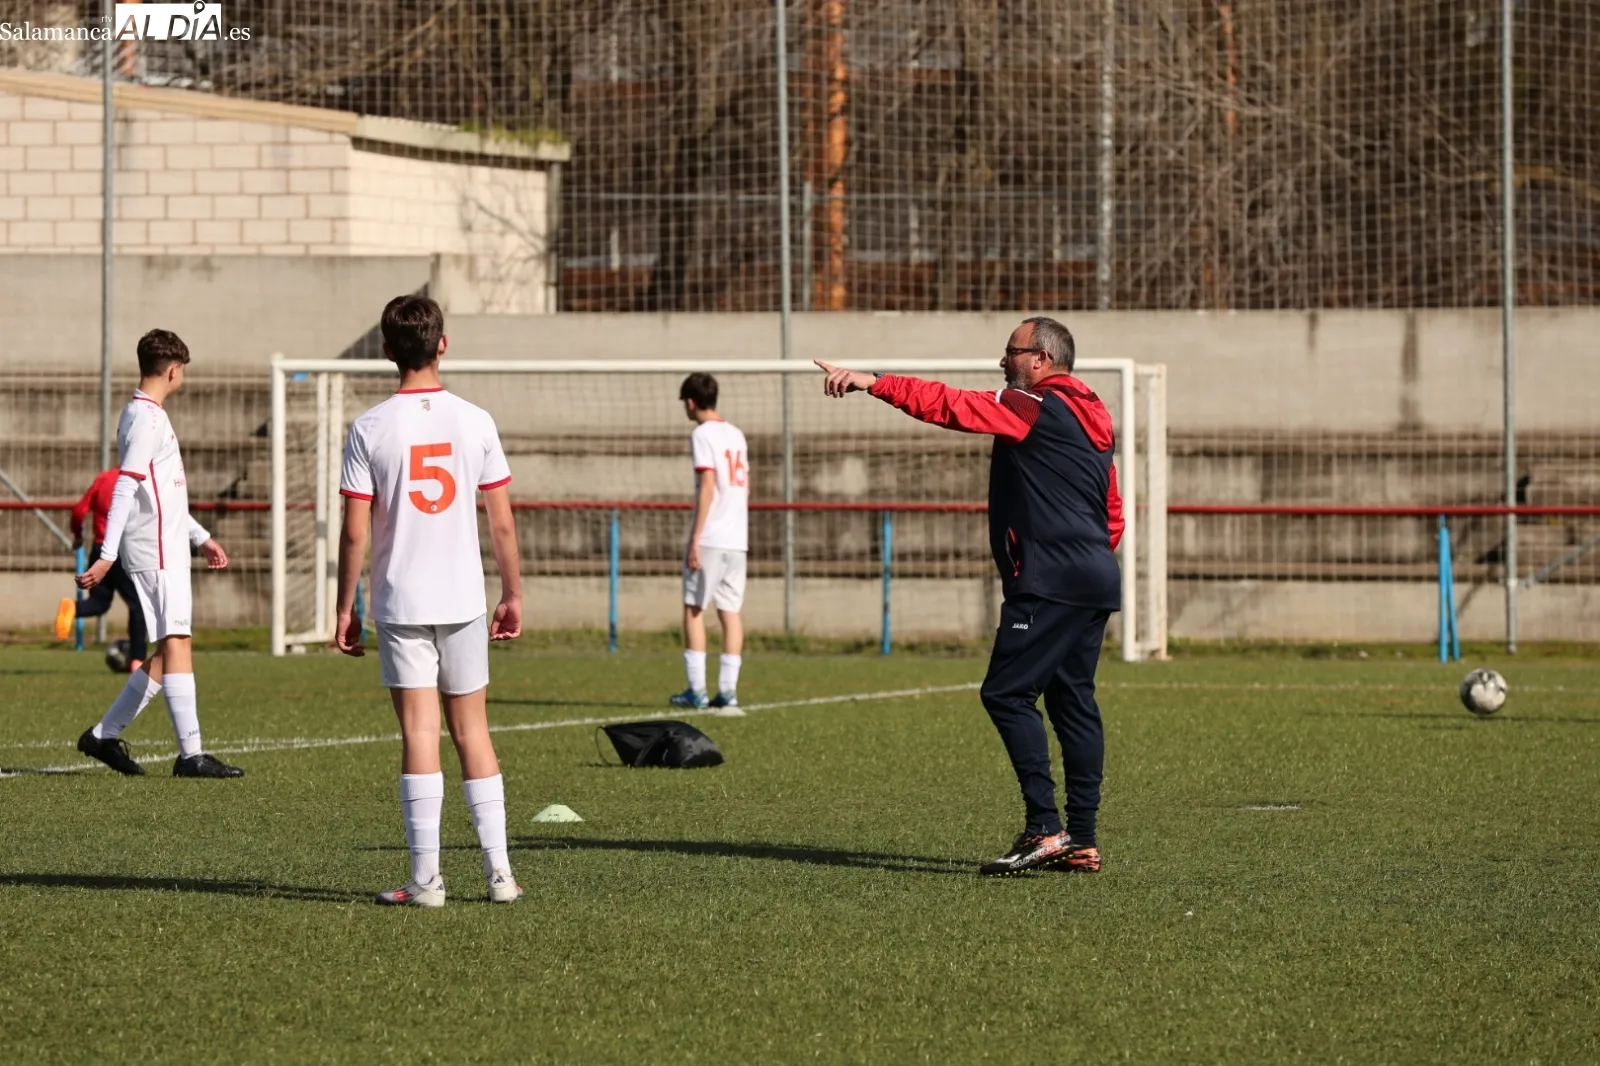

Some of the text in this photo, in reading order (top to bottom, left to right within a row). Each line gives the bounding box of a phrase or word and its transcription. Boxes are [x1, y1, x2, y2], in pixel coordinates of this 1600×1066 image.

[408, 442, 457, 515] 5
[724, 448, 748, 487] 16
[1012, 622, 1029, 630] JAKO
